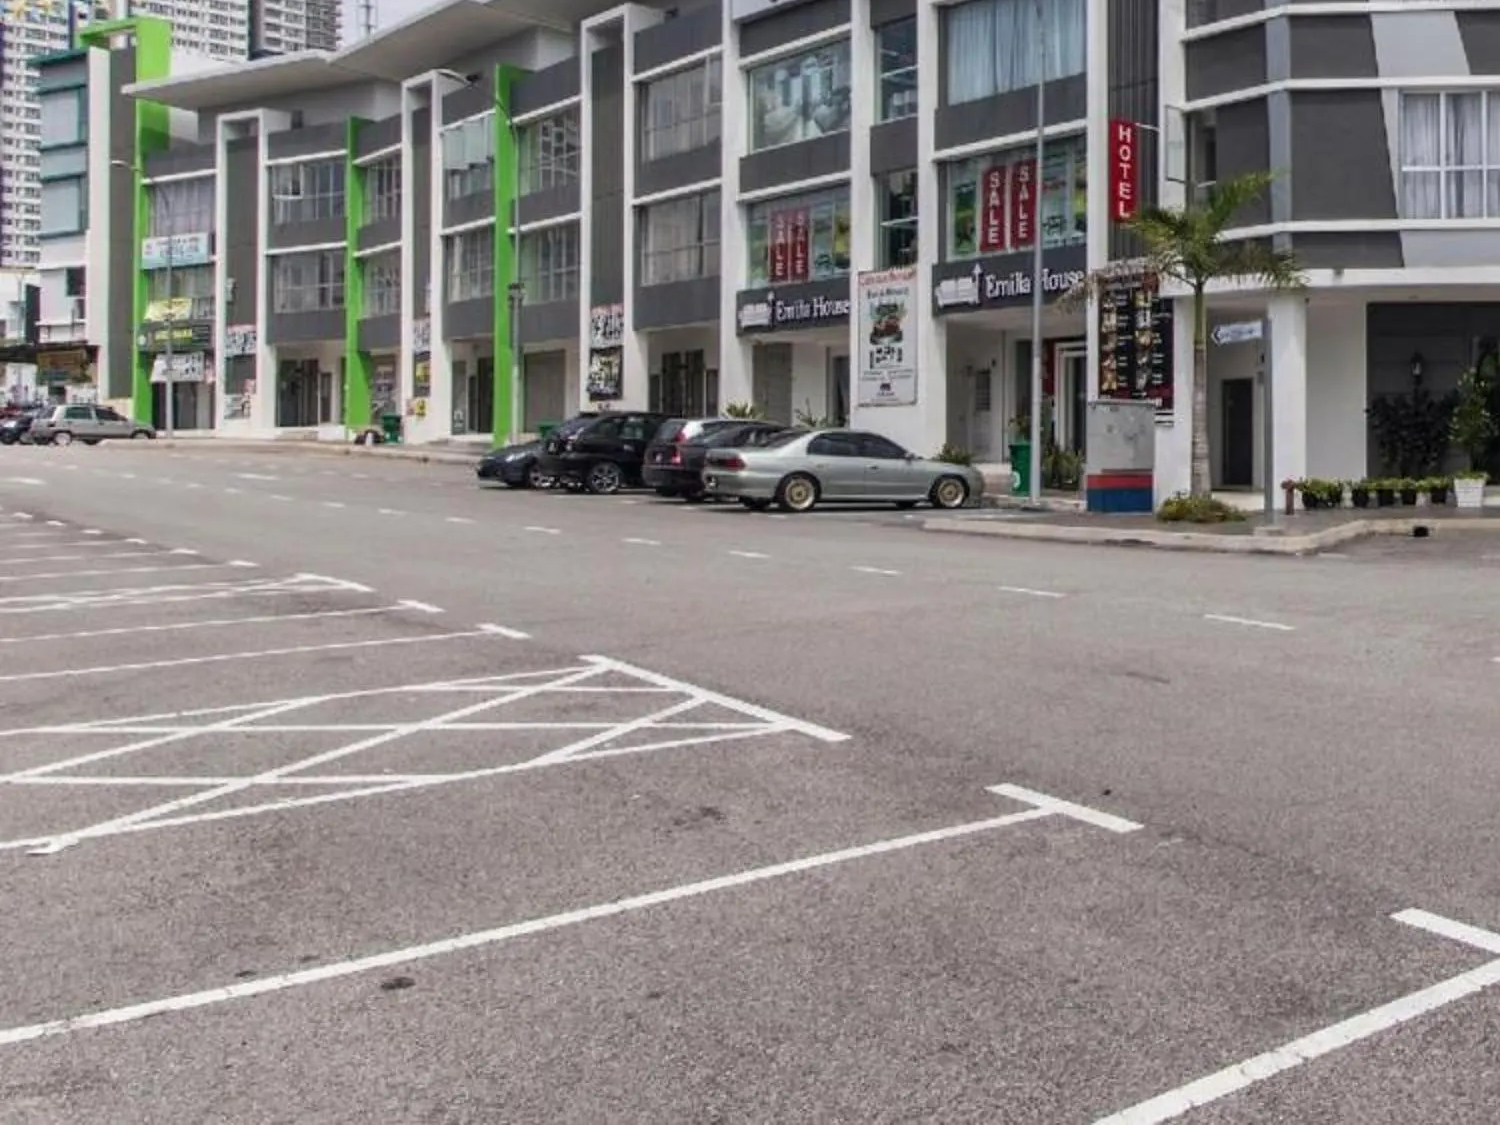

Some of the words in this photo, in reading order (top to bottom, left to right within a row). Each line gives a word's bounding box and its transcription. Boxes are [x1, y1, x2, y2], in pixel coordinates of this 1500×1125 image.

[987, 171, 1001, 244] SALE
[1017, 165, 1030, 238] SALE
[1118, 123, 1132, 219] HOTEL
[774, 213, 786, 276] SALE
[812, 295, 851, 318] House
